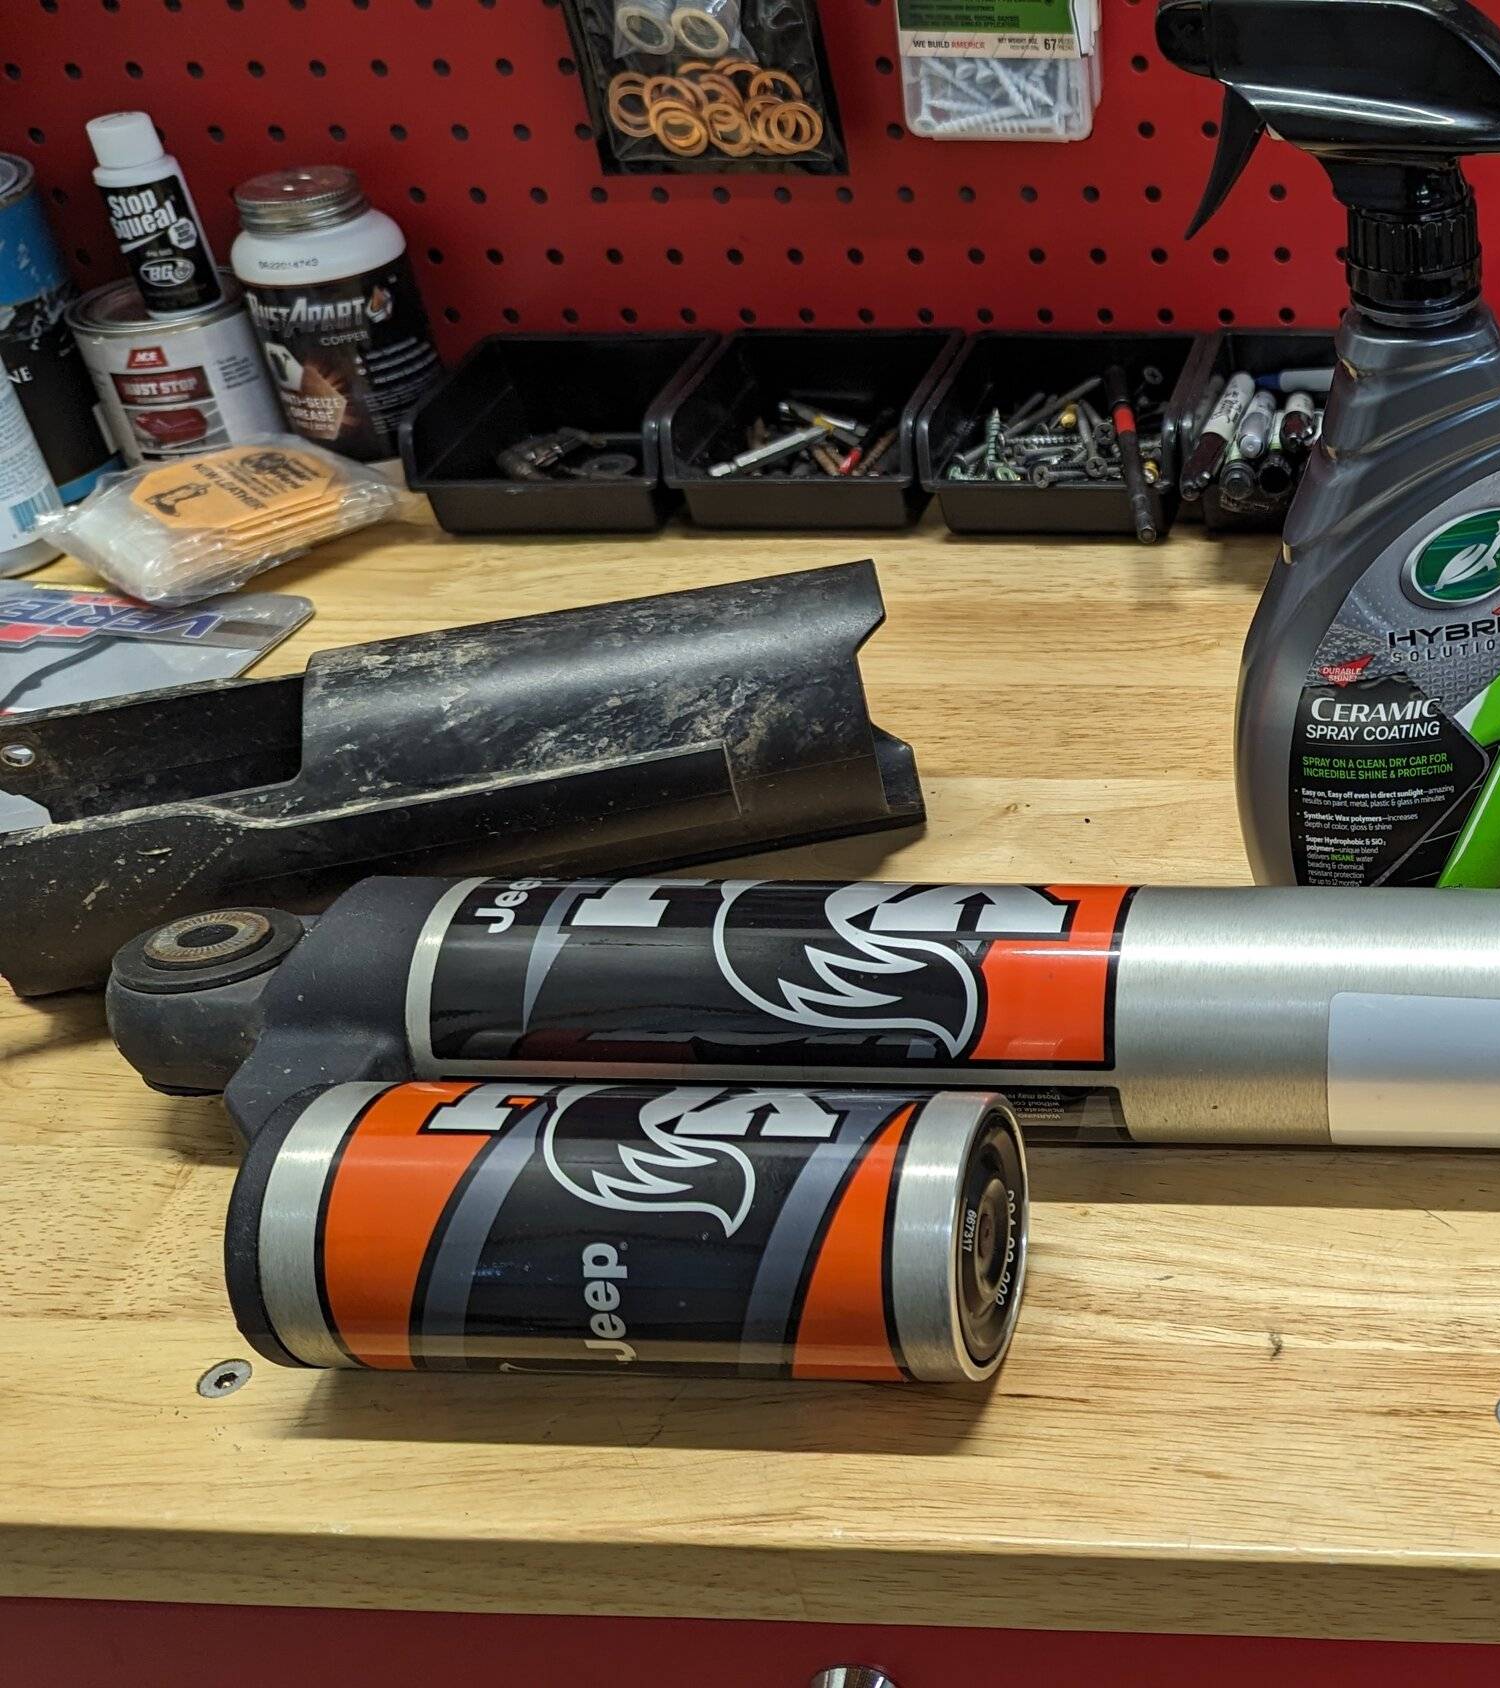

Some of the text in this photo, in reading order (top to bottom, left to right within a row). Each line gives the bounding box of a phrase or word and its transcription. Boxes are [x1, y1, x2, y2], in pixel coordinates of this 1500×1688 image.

[913, 40, 926, 48] WE
[928, 41, 950, 49] BUILD
[1044, 38, 1057, 51] 67
[107, 188, 158, 219] Stop
[148, 263, 174, 282] BG
[319, 330, 370, 347] COPPER
[159, 377, 198, 396] STOP
[1321, 666, 1363, 676] DURABLE
[1310, 697, 1444, 723] CERAMIC
[1305, 720, 1441, 741] SPRAY COATING
[1302, 752, 1448, 769] SPRAY ON A CLEAN, DRY CAR FOR
[1303, 762, 1454, 780] INCREDIBLE SHINE & PROTECTION
[1301, 787, 1316, 798] Easy
[1327, 790, 1343, 800] Easy
[1343, 791, 1353, 799] off
[1370, 791, 1377, 799] in
[1377, 791, 1397, 799] direct
[1302, 797, 1323, 806] results
[1323, 799, 1332, 807] on
[1370, 799, 1390, 808] plastic
[1397, 798, 1413, 808] glass
[1420, 794, 1446, 803] minutes
[1303, 811, 1335, 820] Synthetic
[1335, 814, 1350, 822] Wax
[1304, 820, 1322, 829] depth
[1323, 821, 1331, 829] of
[1350, 823, 1368, 832] gloss
[1374, 823, 1392, 831] shine
[1305, 834, 1323, 844] Super
[1324, 836, 1365, 846] Hydrophobic
[1306, 853, 1330, 861] delivers
[1307, 861, 1331, 869] beading
[1308, 869, 1365, 879] resistant protection
[1308, 876, 1316, 884] for
[474, 877, 552, 933] Jee
[962, 1208, 977, 1253] 667317
[582, 1242, 637, 1362] Jeep
